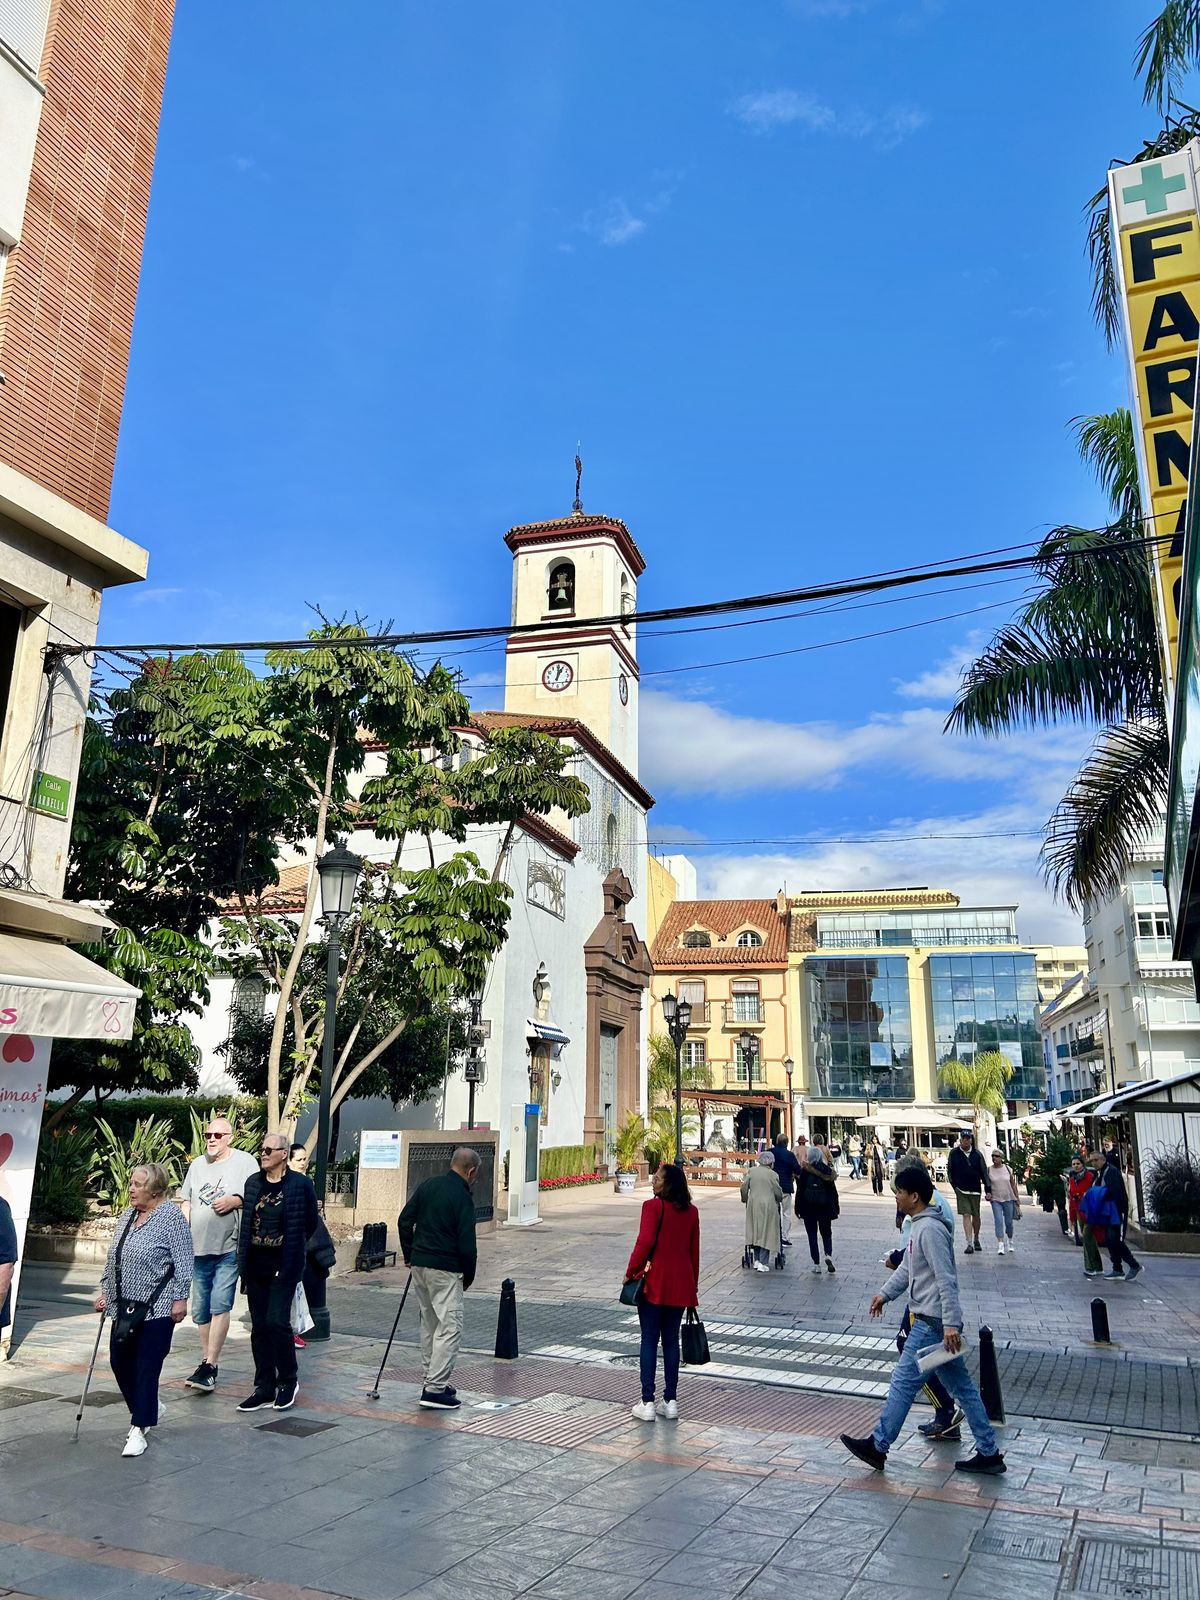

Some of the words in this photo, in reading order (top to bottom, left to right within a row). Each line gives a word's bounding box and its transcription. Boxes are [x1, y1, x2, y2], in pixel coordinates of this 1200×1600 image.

[1129, 221, 1200, 622] FARM
[45, 780, 62, 792] Calle
[33, 794, 65, 810] ARBELLA
